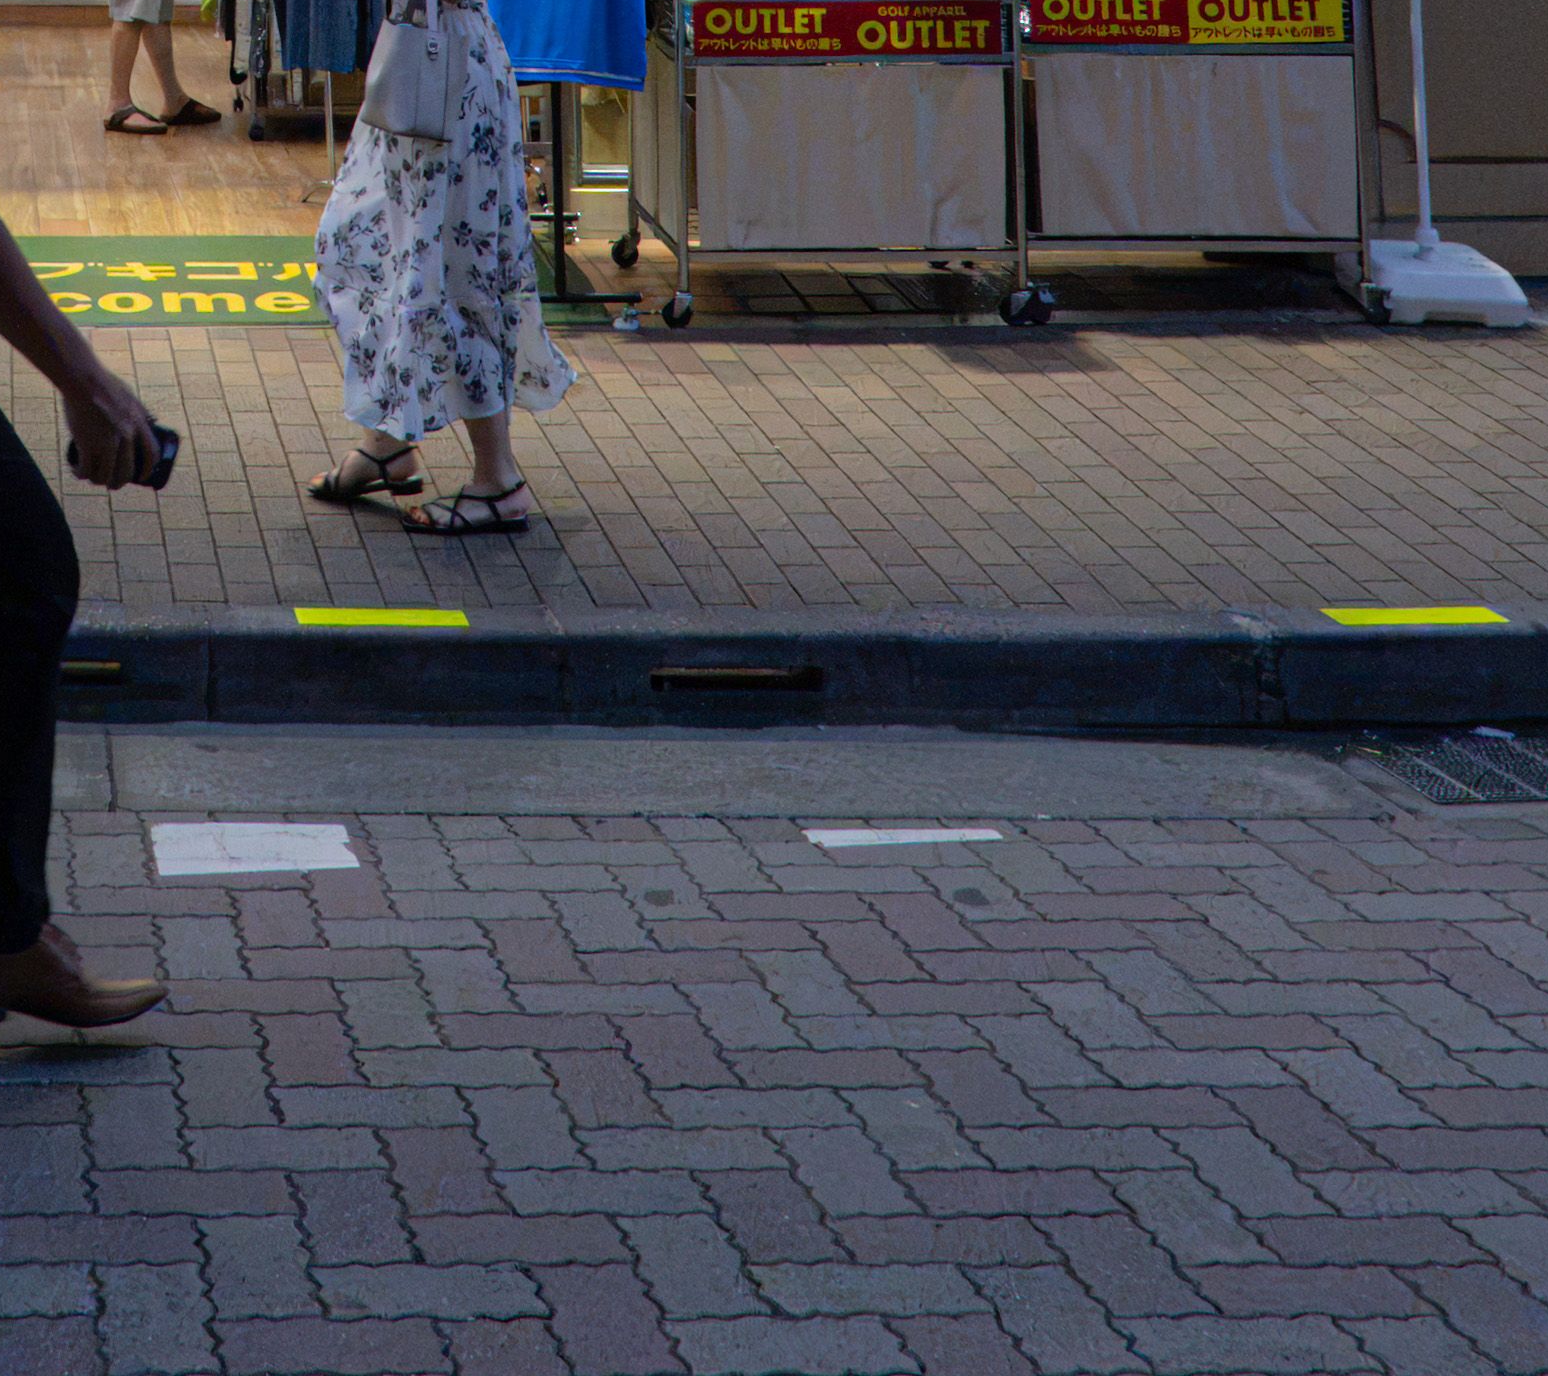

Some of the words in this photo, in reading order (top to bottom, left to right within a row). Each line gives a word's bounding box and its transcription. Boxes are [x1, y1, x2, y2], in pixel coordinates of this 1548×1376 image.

[705, 7, 828, 35] OUTLET
[877, 5, 911, 17] GOLF
[913, 5, 968, 17] APPAREL
[856, 19, 991, 49] OUTLET
[48, 291, 312, 314] come
